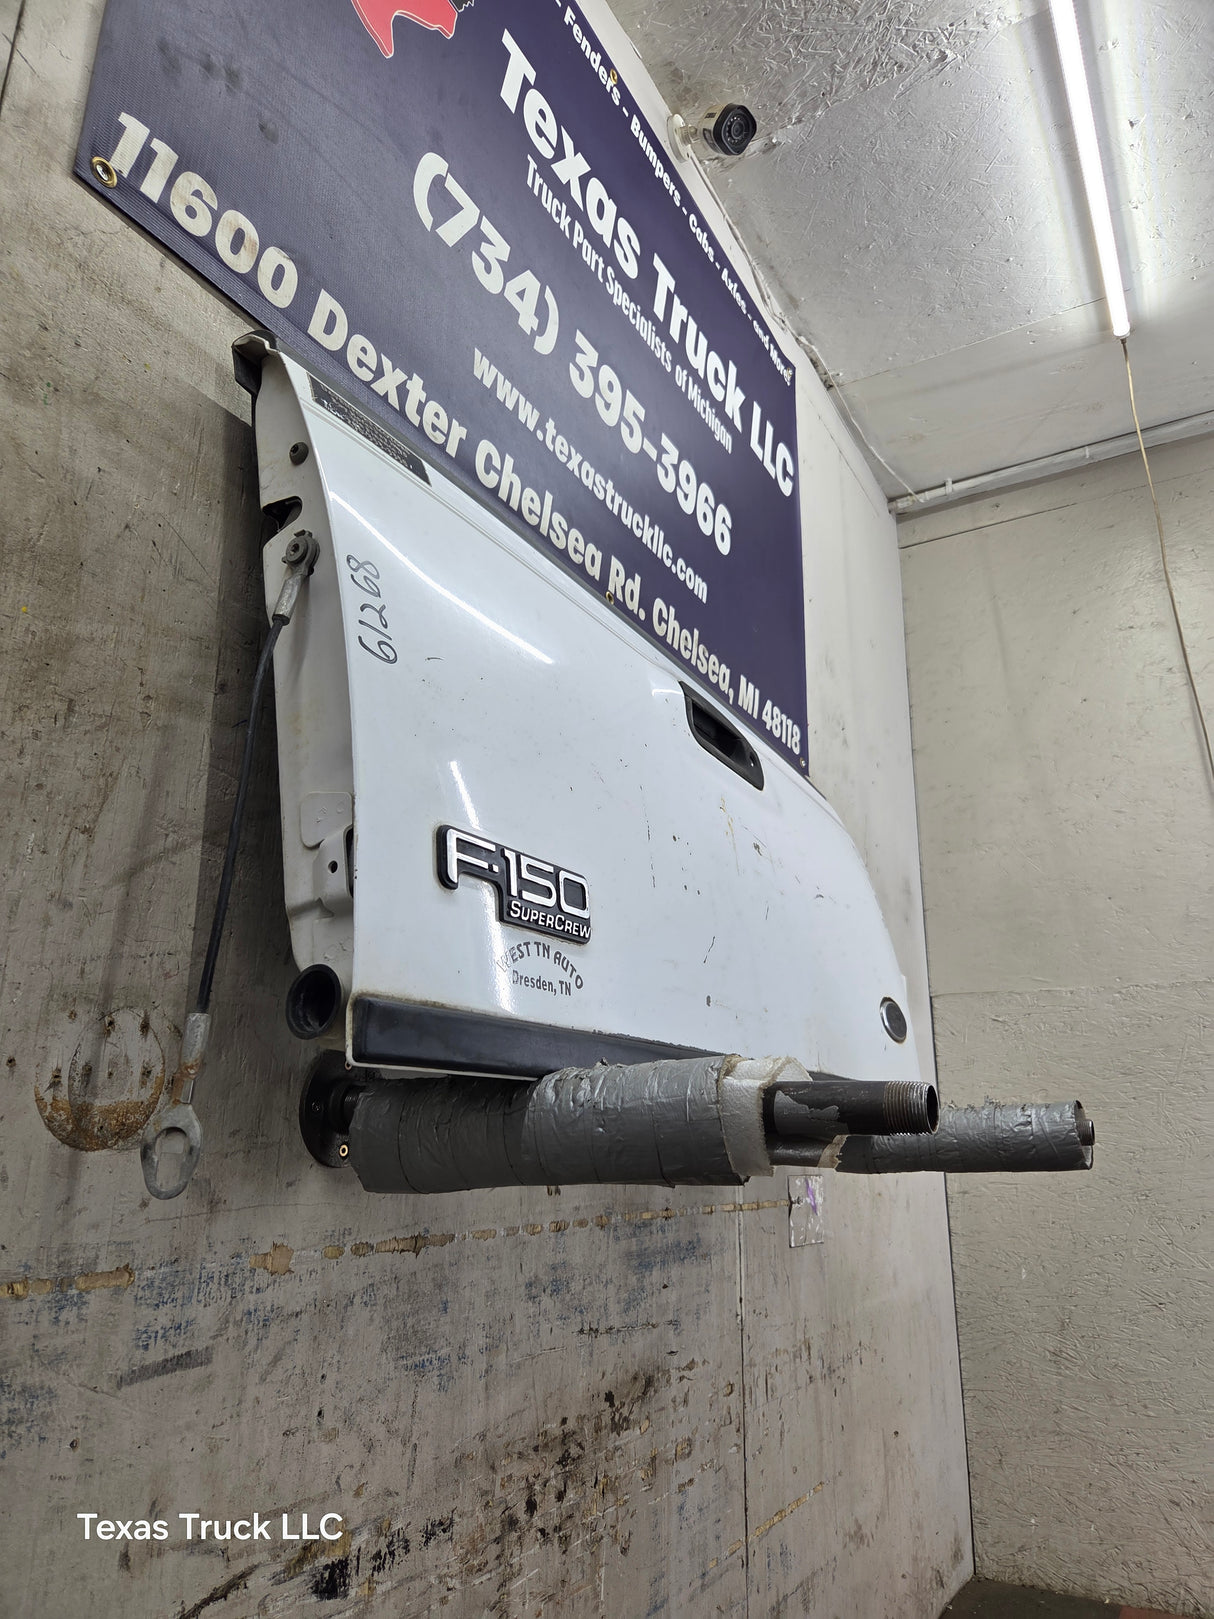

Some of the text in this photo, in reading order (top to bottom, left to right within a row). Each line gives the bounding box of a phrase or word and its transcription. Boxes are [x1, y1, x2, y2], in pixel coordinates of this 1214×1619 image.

[500, 28, 795, 497] Texas Truck LLC
[526, 154, 571, 239] Truck
[572, 220, 604, 283] Part
[605, 265, 672, 373] Specialists
[687, 377, 733, 455] Michigan
[563, 5, 621, 106] Fenders
[630, 114, 681, 207] Bumpers
[689, 213, 715, 263] Cabs
[721, 267, 747, 315] Axles
[752, 320, 770, 351] and
[110, 112, 299, 309] 11600
[306, 288, 468, 458] Dexter
[474, 438, 604, 582] Chelsea
[607, 554, 647, 622] Rd.
[652, 597, 735, 705] Chelsea,
[737, 674, 760, 720] MI
[761, 699, 801, 755] 48118
[413, 152, 733, 556] (734) 395-3966
[472, 346, 709, 604] www.texastruckllc.com
[446, 828, 591, 919] F-150
[512, 969, 573, 997] Dresden, TN
[534, 940, 551, 960] TN
[553, 950, 583, 990] AUTO
